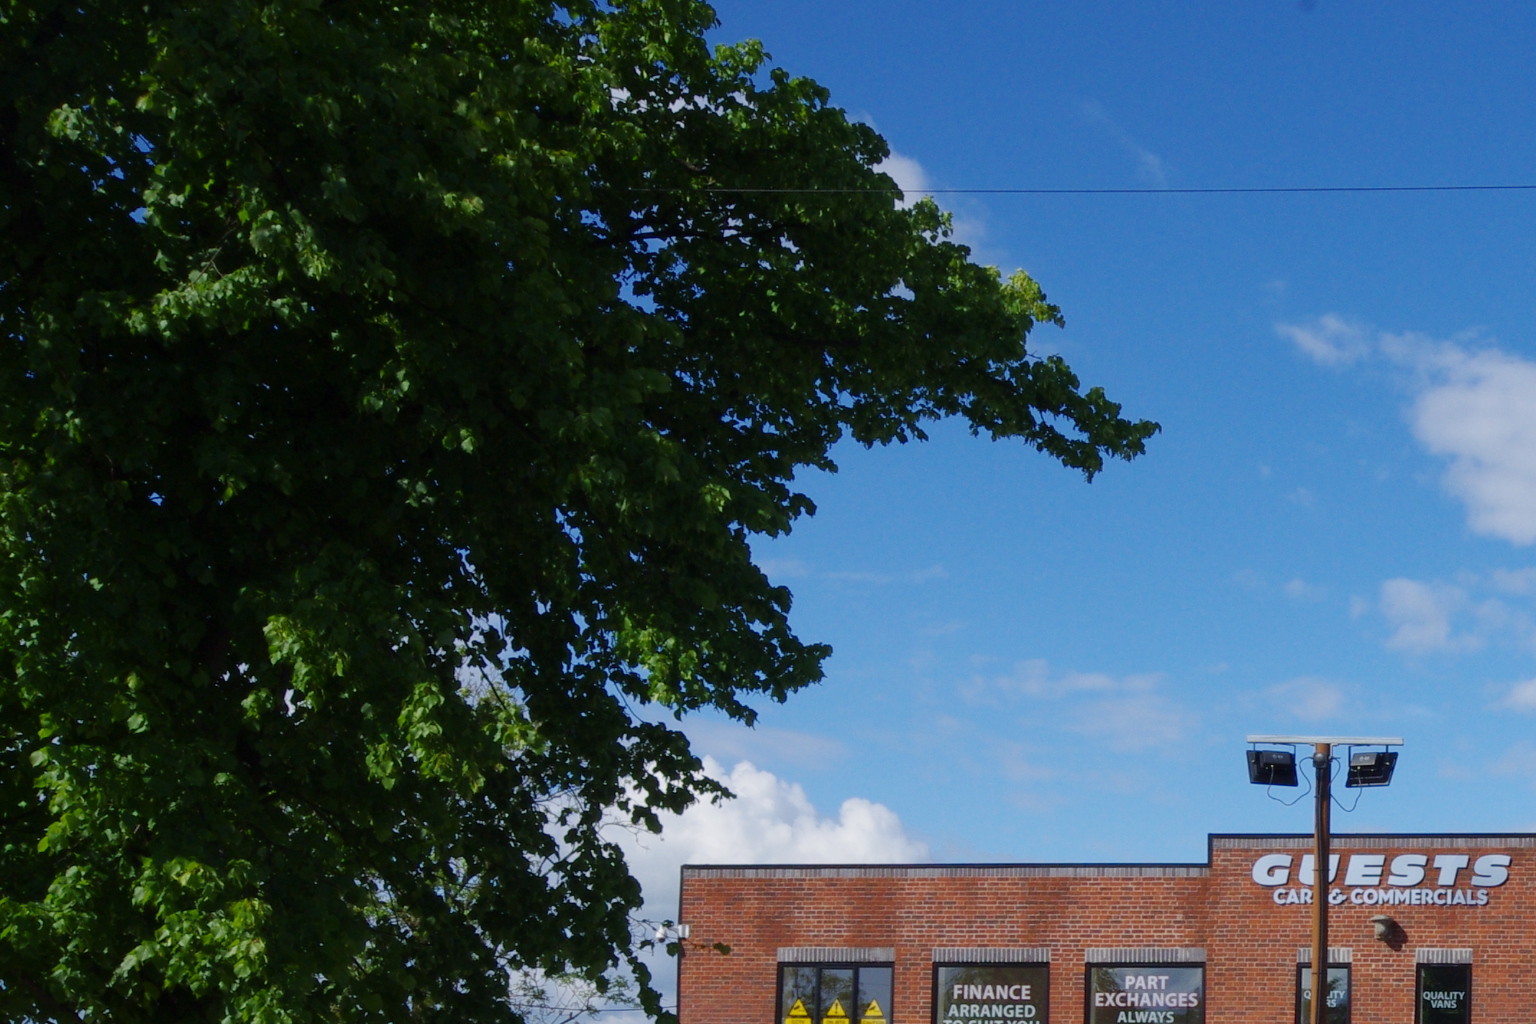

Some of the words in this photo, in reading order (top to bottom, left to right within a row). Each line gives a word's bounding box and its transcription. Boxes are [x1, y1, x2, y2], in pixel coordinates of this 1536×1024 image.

[1252, 854, 1511, 887] GUESTS
[1273, 888, 1314, 905] CAR
[1328, 888, 1347, 905] &
[1351, 888, 1489, 906] COMMERCIALS
[1125, 976, 1169, 990] PART
[953, 984, 1031, 1000] FINANCE
[1304, 990, 1345, 1000] QITY
[1423, 991, 1465, 1001] QUALITY
[1095, 993, 1198, 1007] EXCHANGES
[1431, 1000, 1457, 1009] VANS
[948, 1004, 1036, 1018] ARRANGED
[1117, 1011, 1175, 1023] ALWAYS
